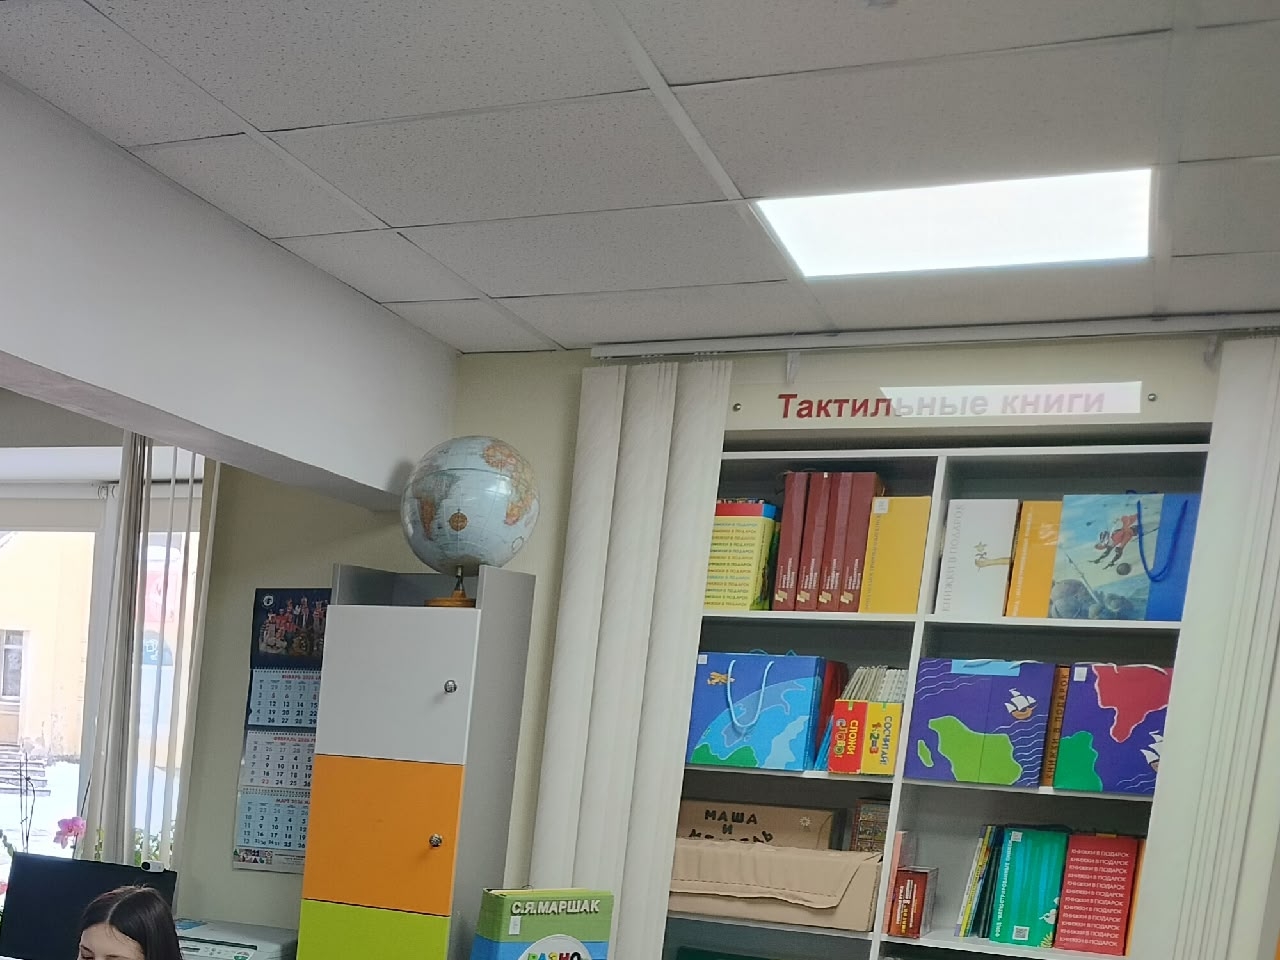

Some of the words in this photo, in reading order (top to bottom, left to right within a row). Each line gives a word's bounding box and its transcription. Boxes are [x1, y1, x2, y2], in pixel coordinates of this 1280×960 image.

[778, 393, 988, 418] Тактильные
[1001, 391, 1106, 415] книги
[847, 720, 859, 755] СЛОЖИ
[704, 809, 759, 825] МАША
[722, 824, 733, 835] И
[511, 899, 601, 917] С.Я.МАРШАК
